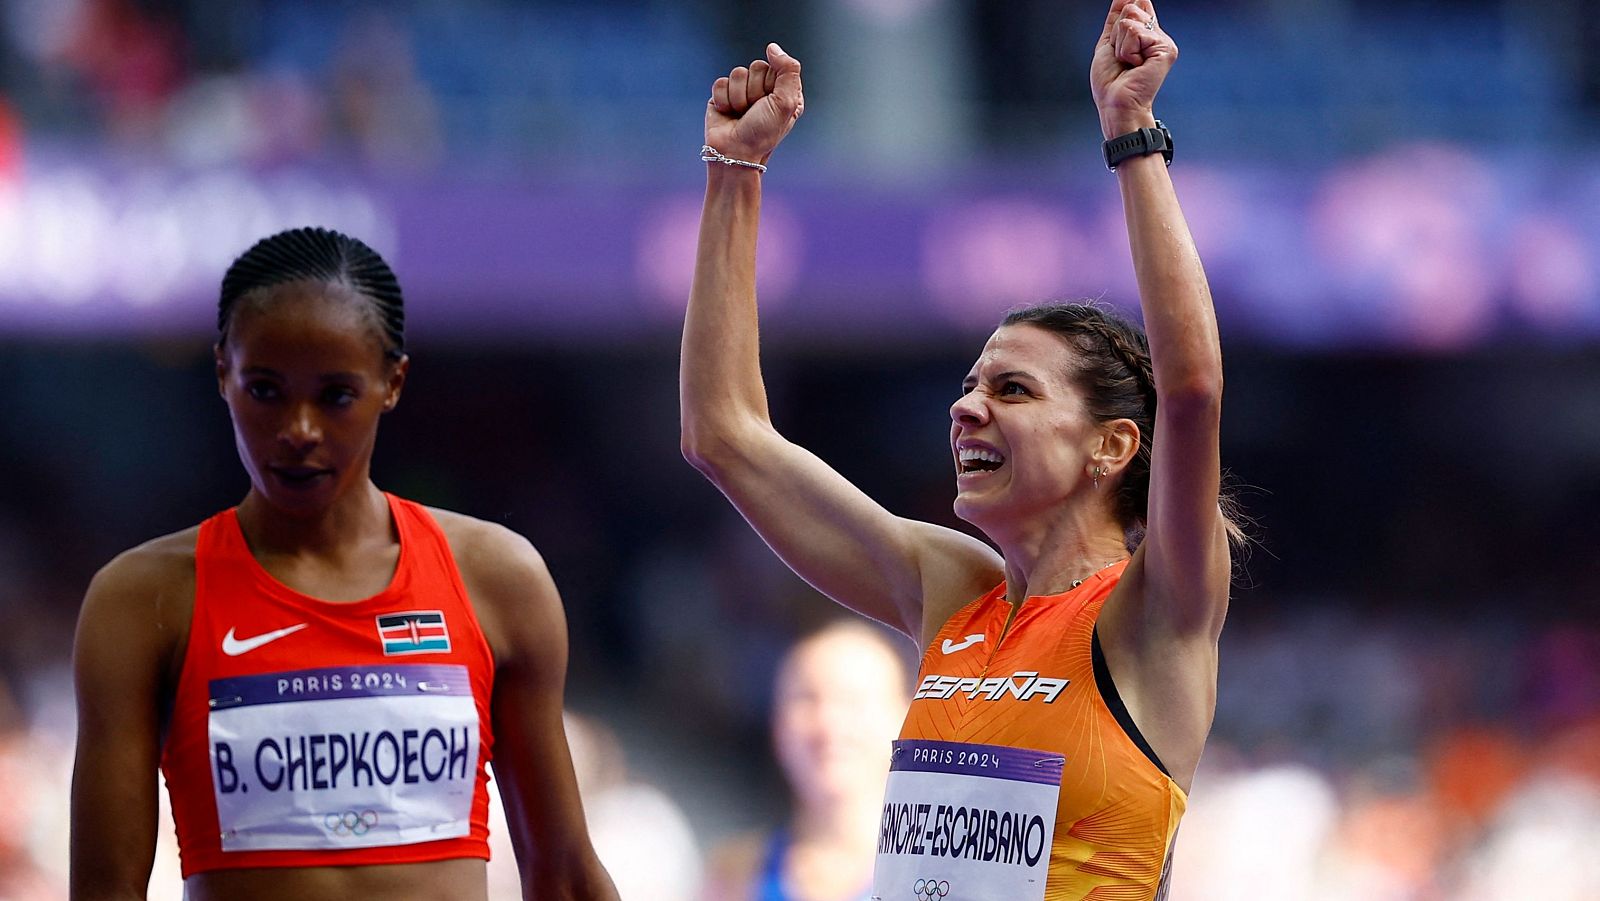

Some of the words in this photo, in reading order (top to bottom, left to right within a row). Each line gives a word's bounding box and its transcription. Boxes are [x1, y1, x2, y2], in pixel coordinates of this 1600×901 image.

[351, 672, 407, 691] 2024
[913, 671, 1071, 704] ESPAÑA
[215, 741, 248, 794] B.
[254, 726, 469, 793] CHEPKOECH
[957, 751, 1000, 769] 2024
